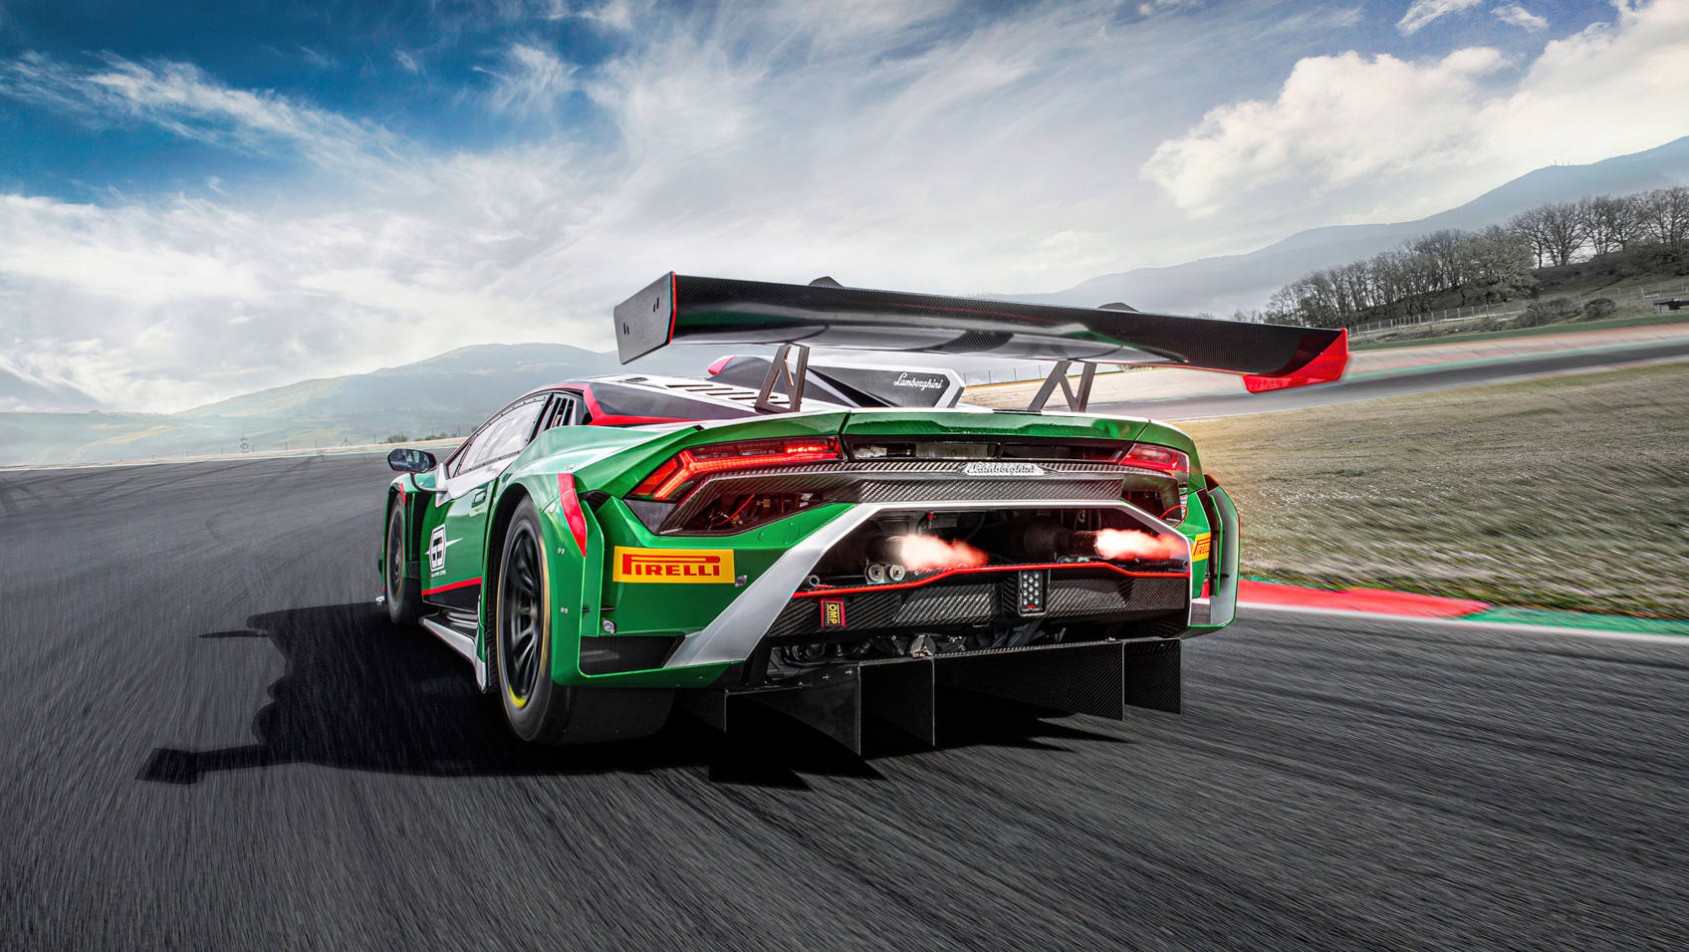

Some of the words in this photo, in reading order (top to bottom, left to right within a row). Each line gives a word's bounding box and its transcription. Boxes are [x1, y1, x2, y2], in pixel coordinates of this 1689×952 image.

[893, 372, 943, 391] Lamborghini
[967, 463, 1034, 475] Lamborghini
[622, 553, 721, 576] PIRELLI
[829, 603, 838, 624] OMP
